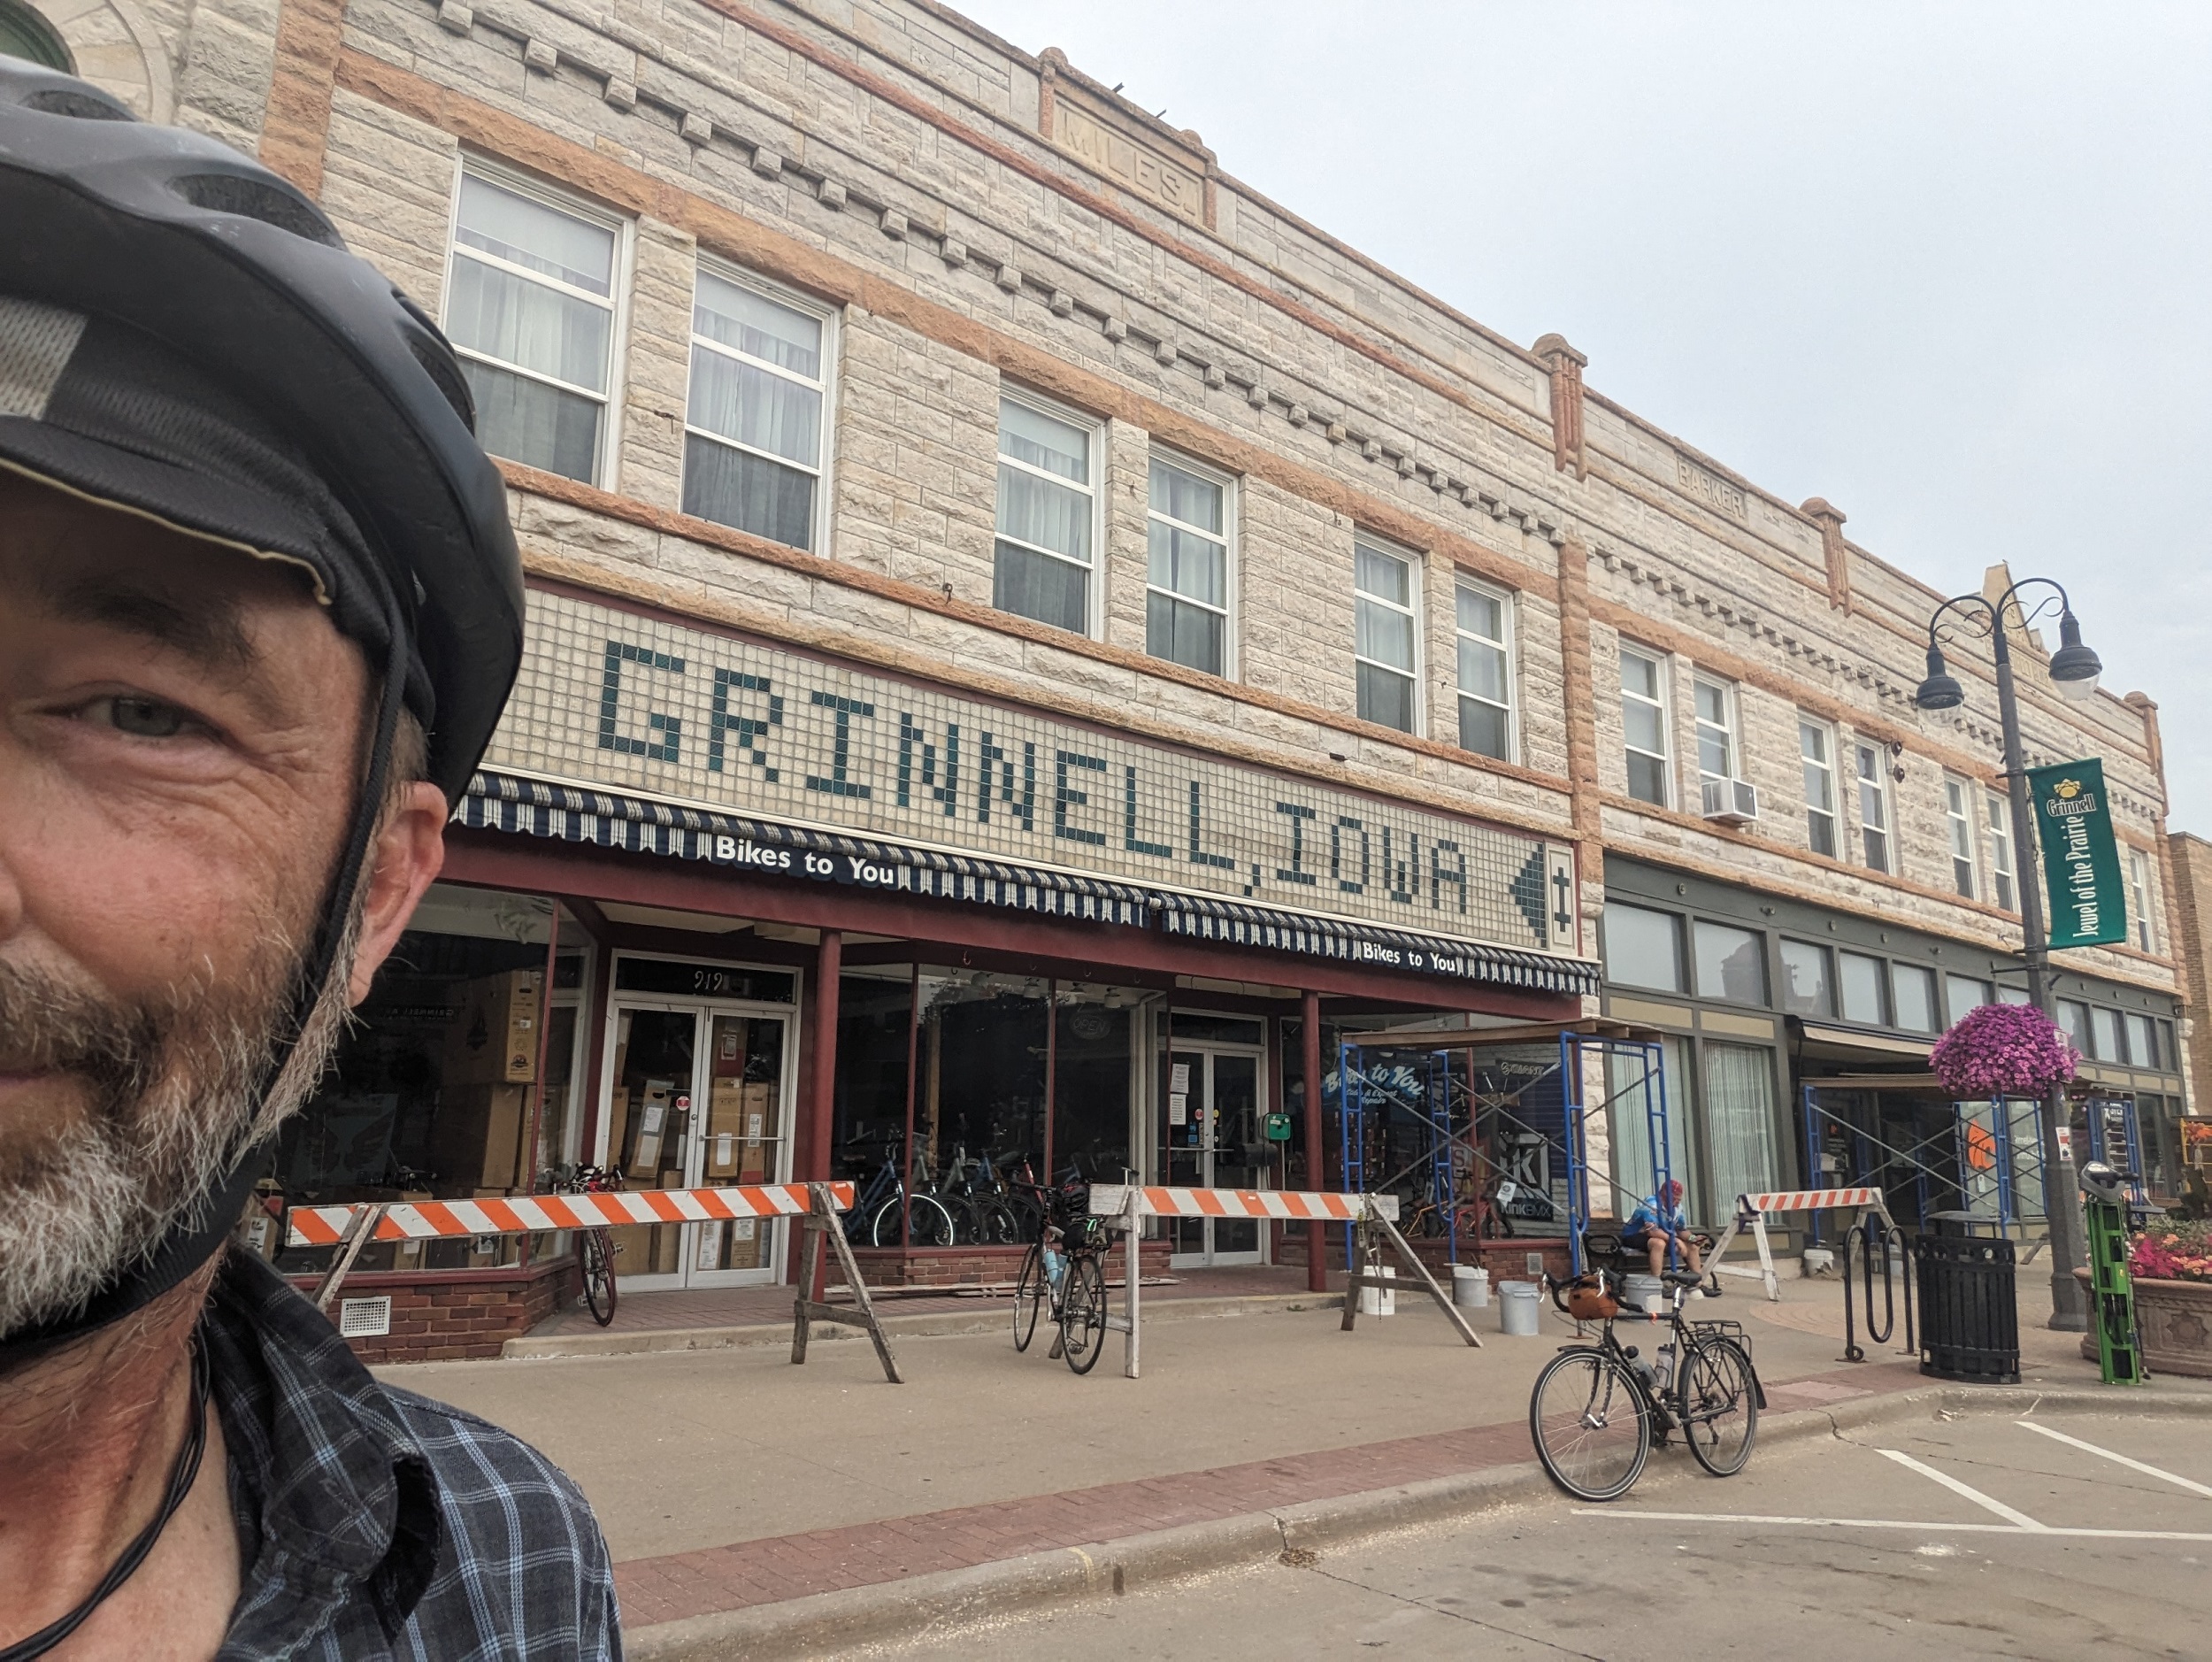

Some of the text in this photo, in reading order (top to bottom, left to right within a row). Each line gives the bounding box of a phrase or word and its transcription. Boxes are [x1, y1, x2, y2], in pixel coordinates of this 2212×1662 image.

[2047, 793, 2096, 817] Grinnell
[717, 835, 894, 884] Bikes to You
[1276, 802, 1467, 914] IOWA
[2060, 816, 2099, 937] Jewel of the Prairie
[1363, 941, 1455, 972] Bikes to You
[694, 971, 722, 991] 919
[1073, 1017, 1106, 1034] OPEN
[1371, 1064, 1390, 1083] to
[1391, 1066, 1425, 1095] You
